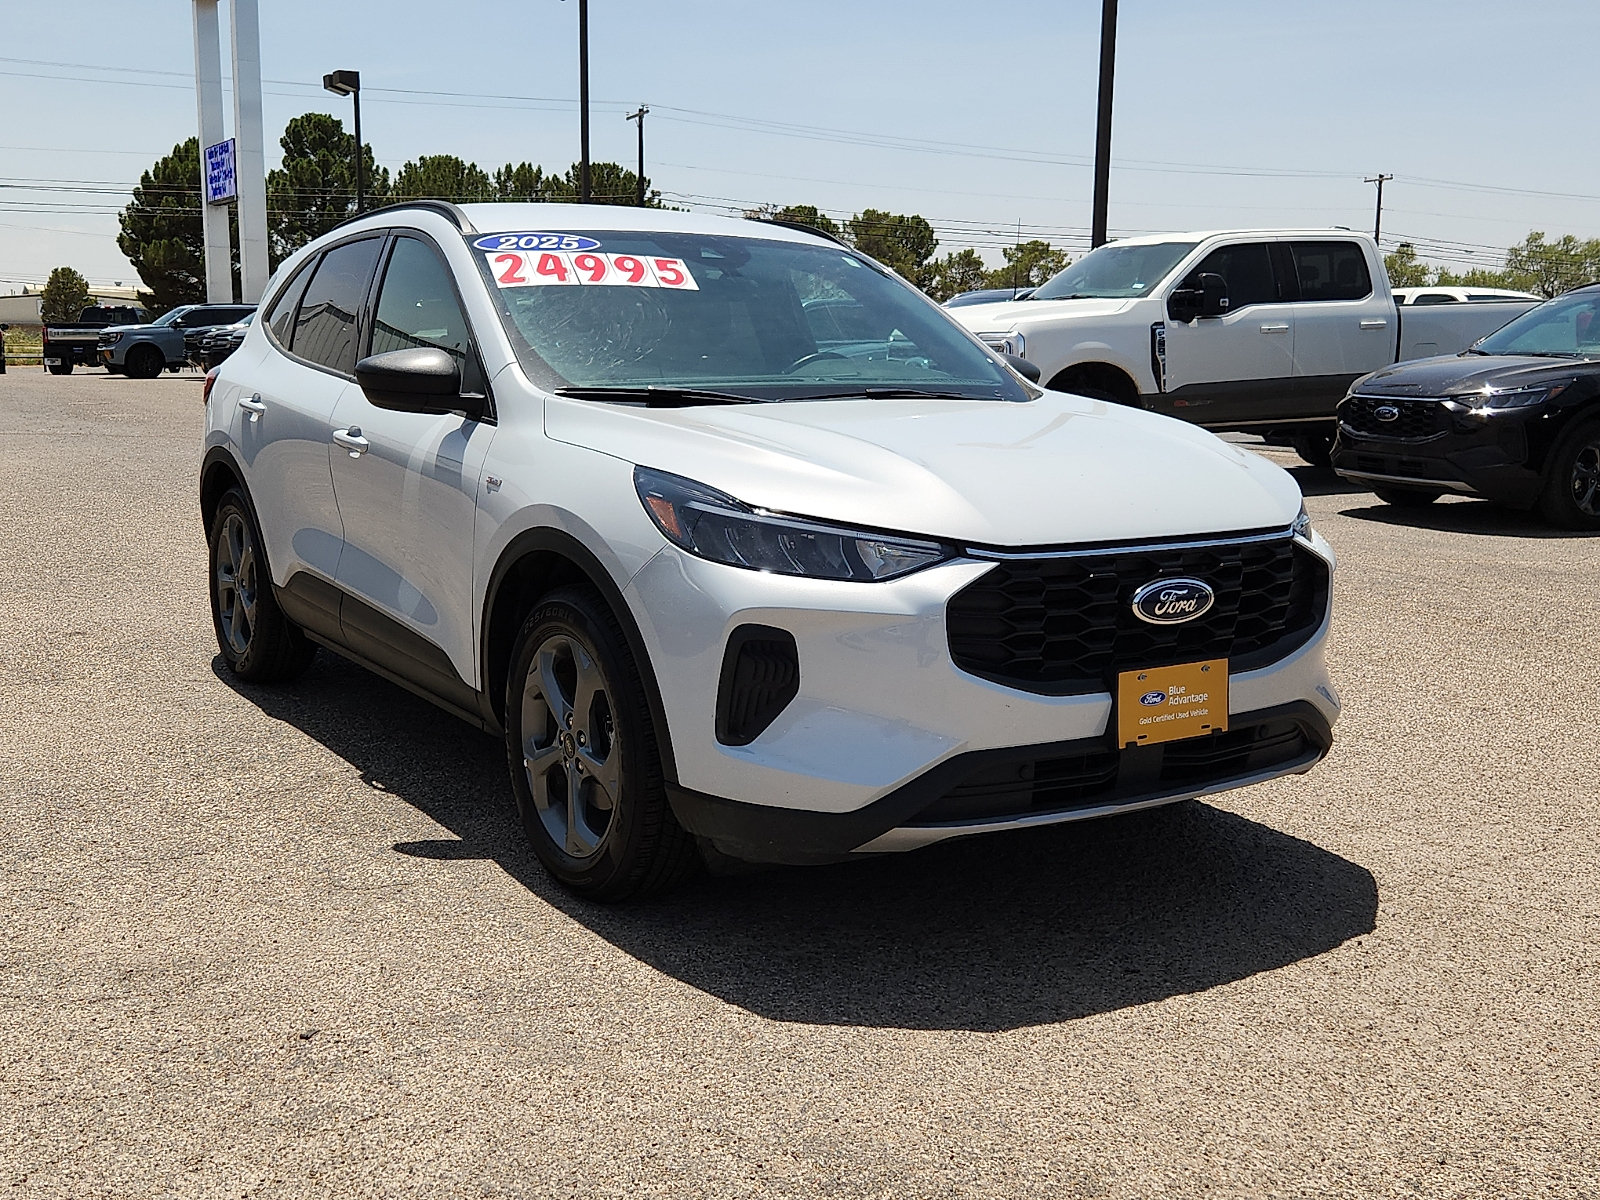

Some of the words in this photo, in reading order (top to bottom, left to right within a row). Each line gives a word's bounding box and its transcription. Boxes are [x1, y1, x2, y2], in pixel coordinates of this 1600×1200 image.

[497, 236, 580, 250] 2025
[494, 253, 686, 286] 24995
[1154, 589, 1204, 616] Ford
[1168, 685, 1186, 696] Blue
[1143, 692, 1163, 705] Ford
[1168, 693, 1209, 706] Advantage
[1139, 717, 1152, 725] Gold
[1152, 713, 1175, 723] Certified
[1175, 711, 1189, 719] Used
[1189, 708, 1208, 717] Vehicle
